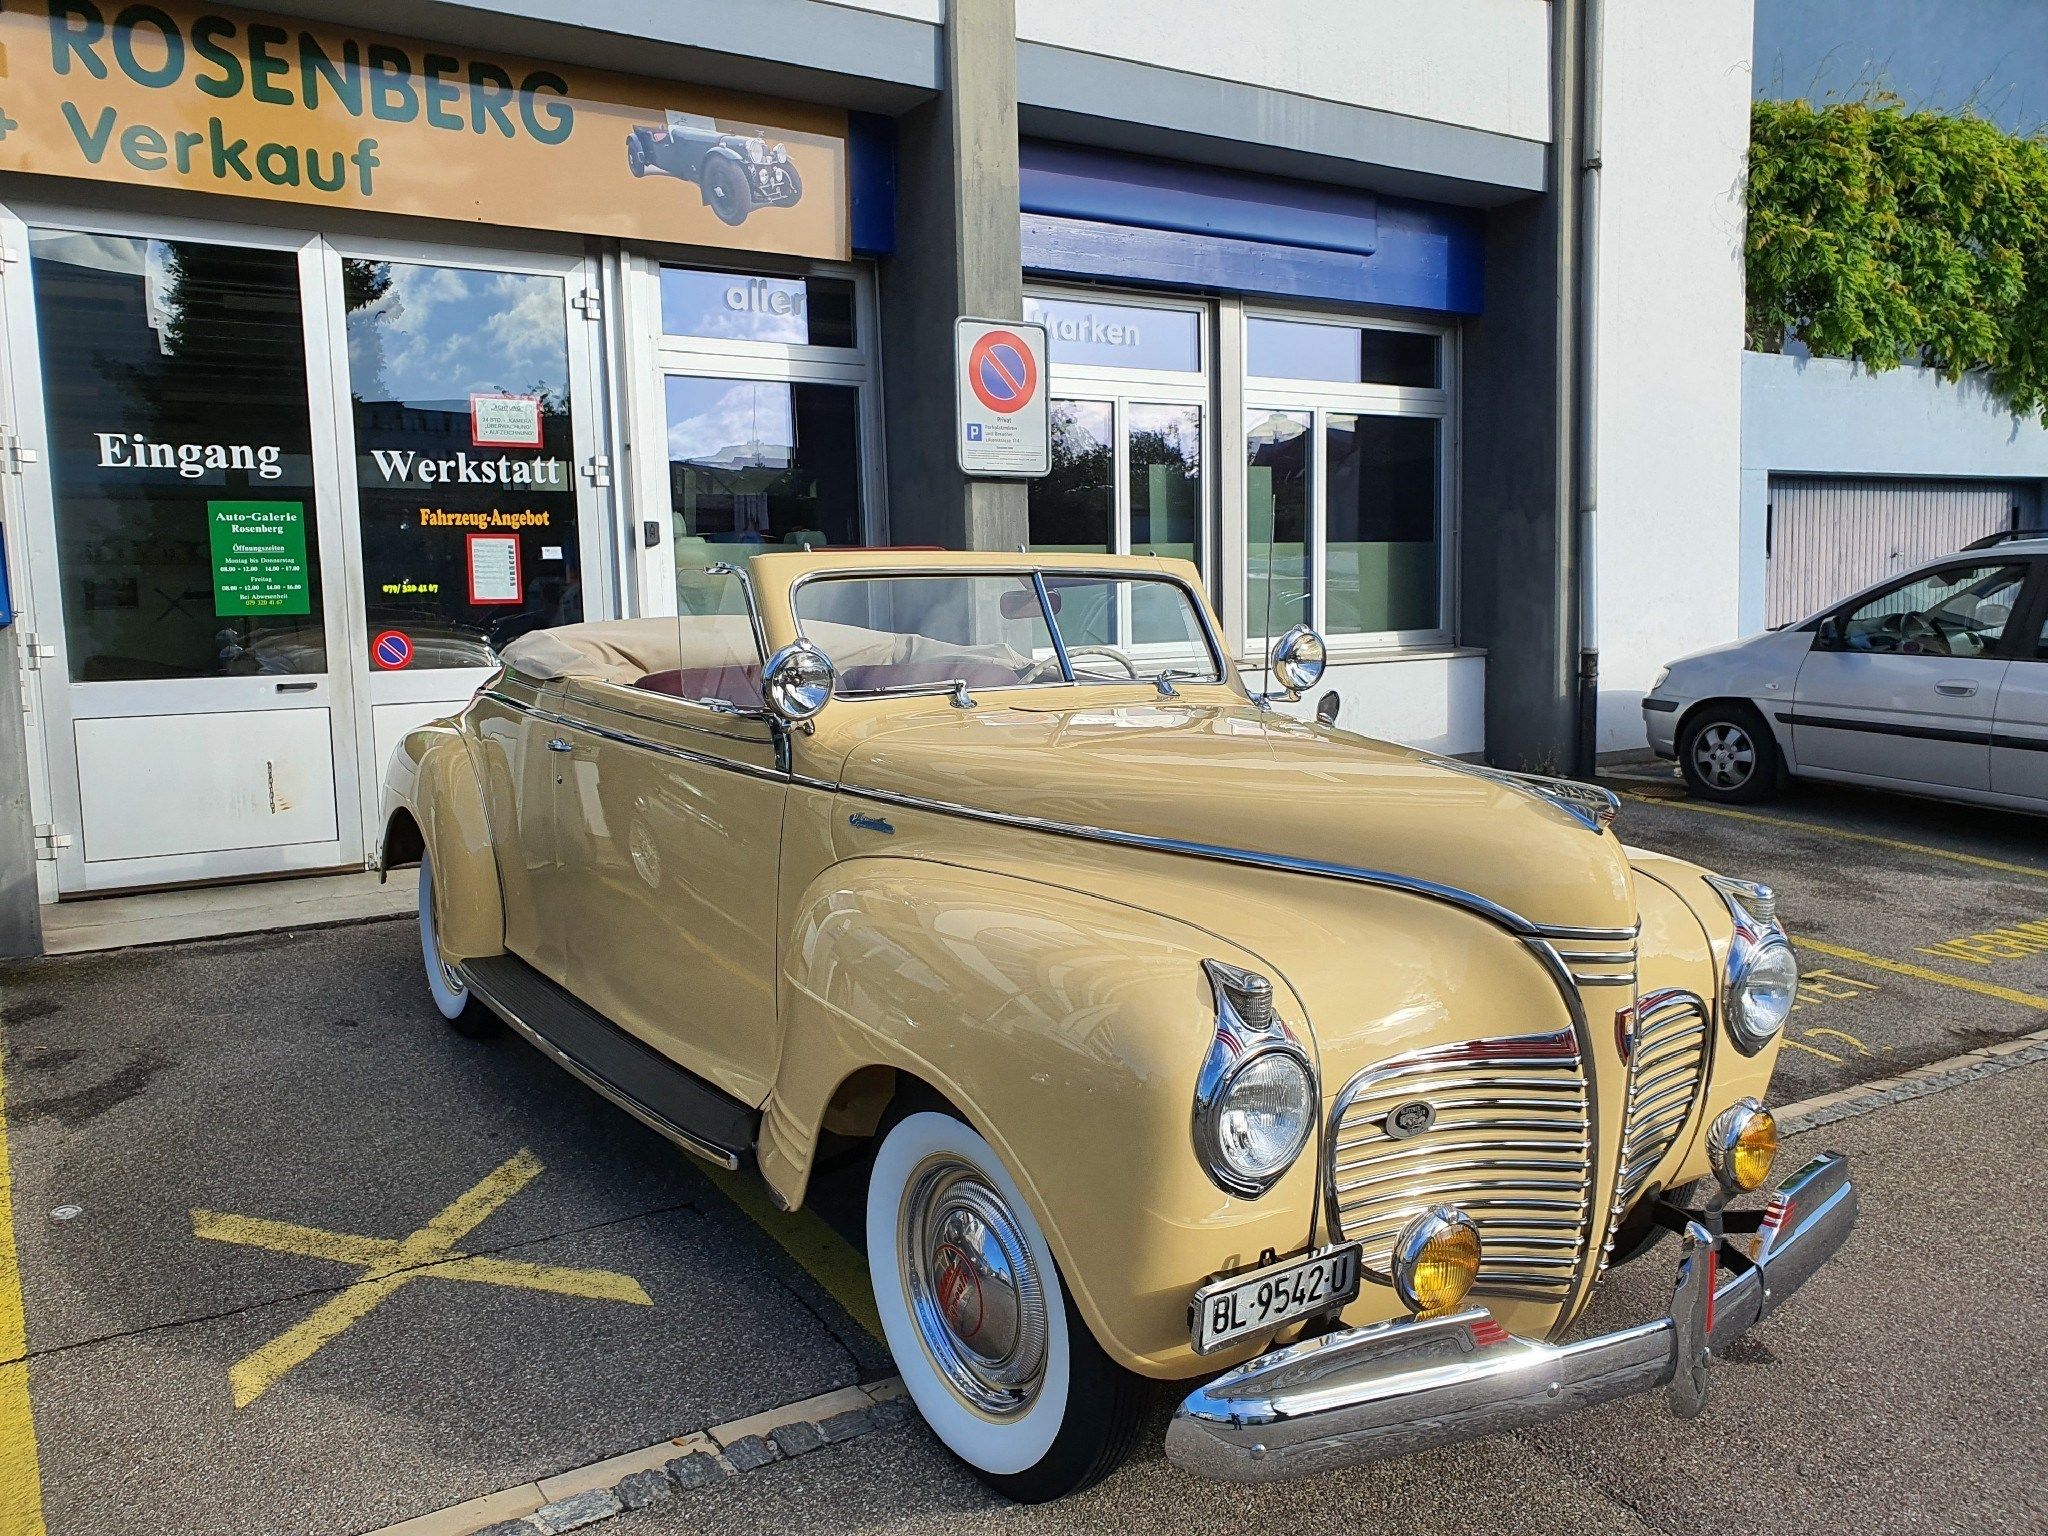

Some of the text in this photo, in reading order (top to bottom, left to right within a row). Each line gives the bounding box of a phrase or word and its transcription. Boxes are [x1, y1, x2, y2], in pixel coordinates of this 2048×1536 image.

[48, 0, 574, 145] ROSENBERG
[61, 101, 380, 196] Verkauf
[723, 278, 807, 316] aller
[997, 416, 1012, 424] Privat
[93, 432, 283, 479] Eingang
[370, 450, 560, 485] Werkstatt
[216, 512, 297, 521] Auto-Galerie
[231, 524, 284, 535] Rosenberg
[419, 508, 550, 530] Fahrzeug-Angebot
[232, 543, 285, 552] Öffnungszeiten
